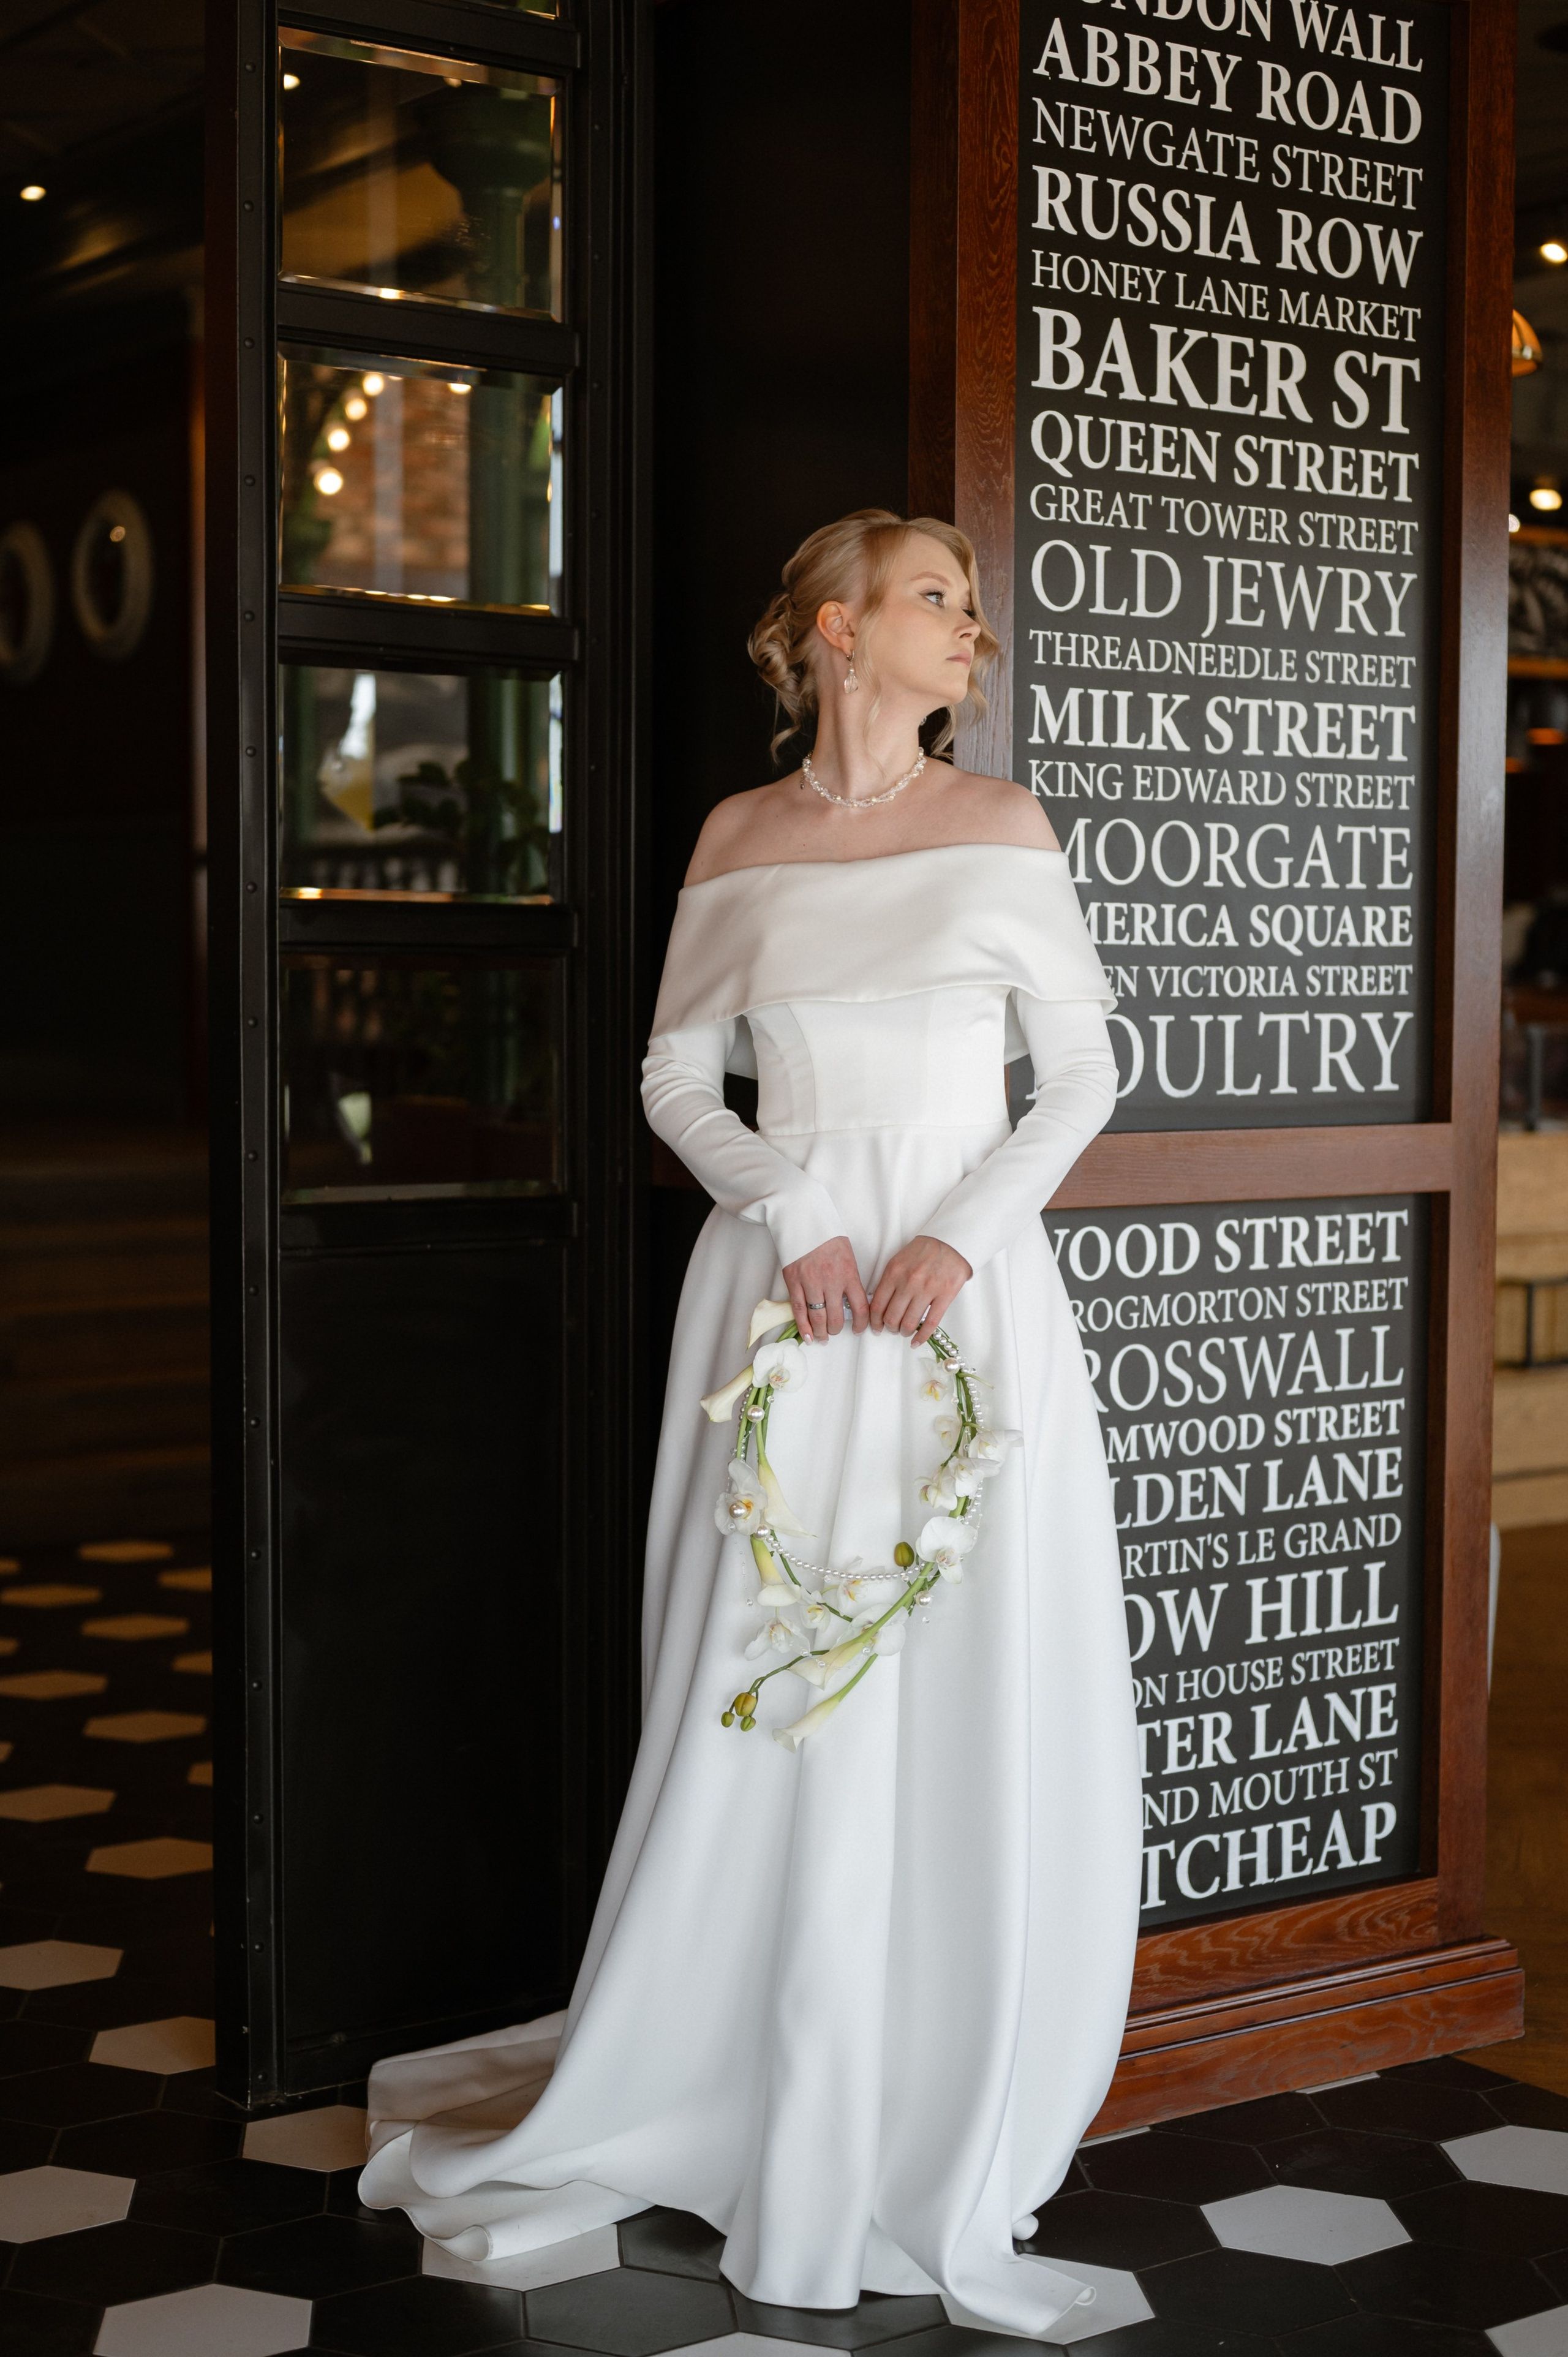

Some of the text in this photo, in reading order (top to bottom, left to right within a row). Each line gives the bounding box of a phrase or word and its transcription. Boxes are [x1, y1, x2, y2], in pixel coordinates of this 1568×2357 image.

[1291, 0, 1423, 72] WALL
[1033, 17, 1242, 112] ABBEY
[1257, 60, 1422, 144] ROAD
[1032, 97, 1422, 209] NEWGATE STREET
[1032, 165, 1423, 288] RUSSIA ROW
[1032, 249, 1421, 342] HONEY LANE MARKET
[1031, 306, 1420, 434] BAKER ST
[1031, 410, 1419, 502] QUEEN STREET
[1030, 483, 1419, 555] GREAT TOWER STREET
[1031, 539, 1417, 638] OLD JEWRY
[1029, 629, 1416, 688] THREADNEEDLE STREET
[1028, 684, 1415, 762] MILK STREET
[1028, 760, 1415, 810] KING EDWARD STREET
[1083, 902, 1413, 956] ERICA SQUARE
[1147, 965, 1299, 997] VICTORIA
[1306, 964, 1413, 996] STREET
[1025, 1011, 1414, 1099] ULTRY
[1052, 1210, 1408, 1281] OOD STREET
[1071, 1277, 1408, 1332] ROGMORTON STREET
[1083, 1325, 1404, 1412] OSSWALL
[1106, 1398, 1405, 1463] MWOOD STREET
[1112, 1447, 1404, 1531] LDEN LANE
[1123, 1513, 1401, 1580] RTIN'S LE GRAND
[1245, 1561, 1400, 1645] HILL
[1176, 1657, 1284, 1703] HOUSE
[1291, 1637, 1400, 1686] STREET
[1137, 1711, 1237, 1779] TER
[1249, 1683, 1399, 1760] LANE
[1143, 1749, 1398, 1830] ND MOUTH ST
[1140, 1801, 1397, 1910] TCHEAP
